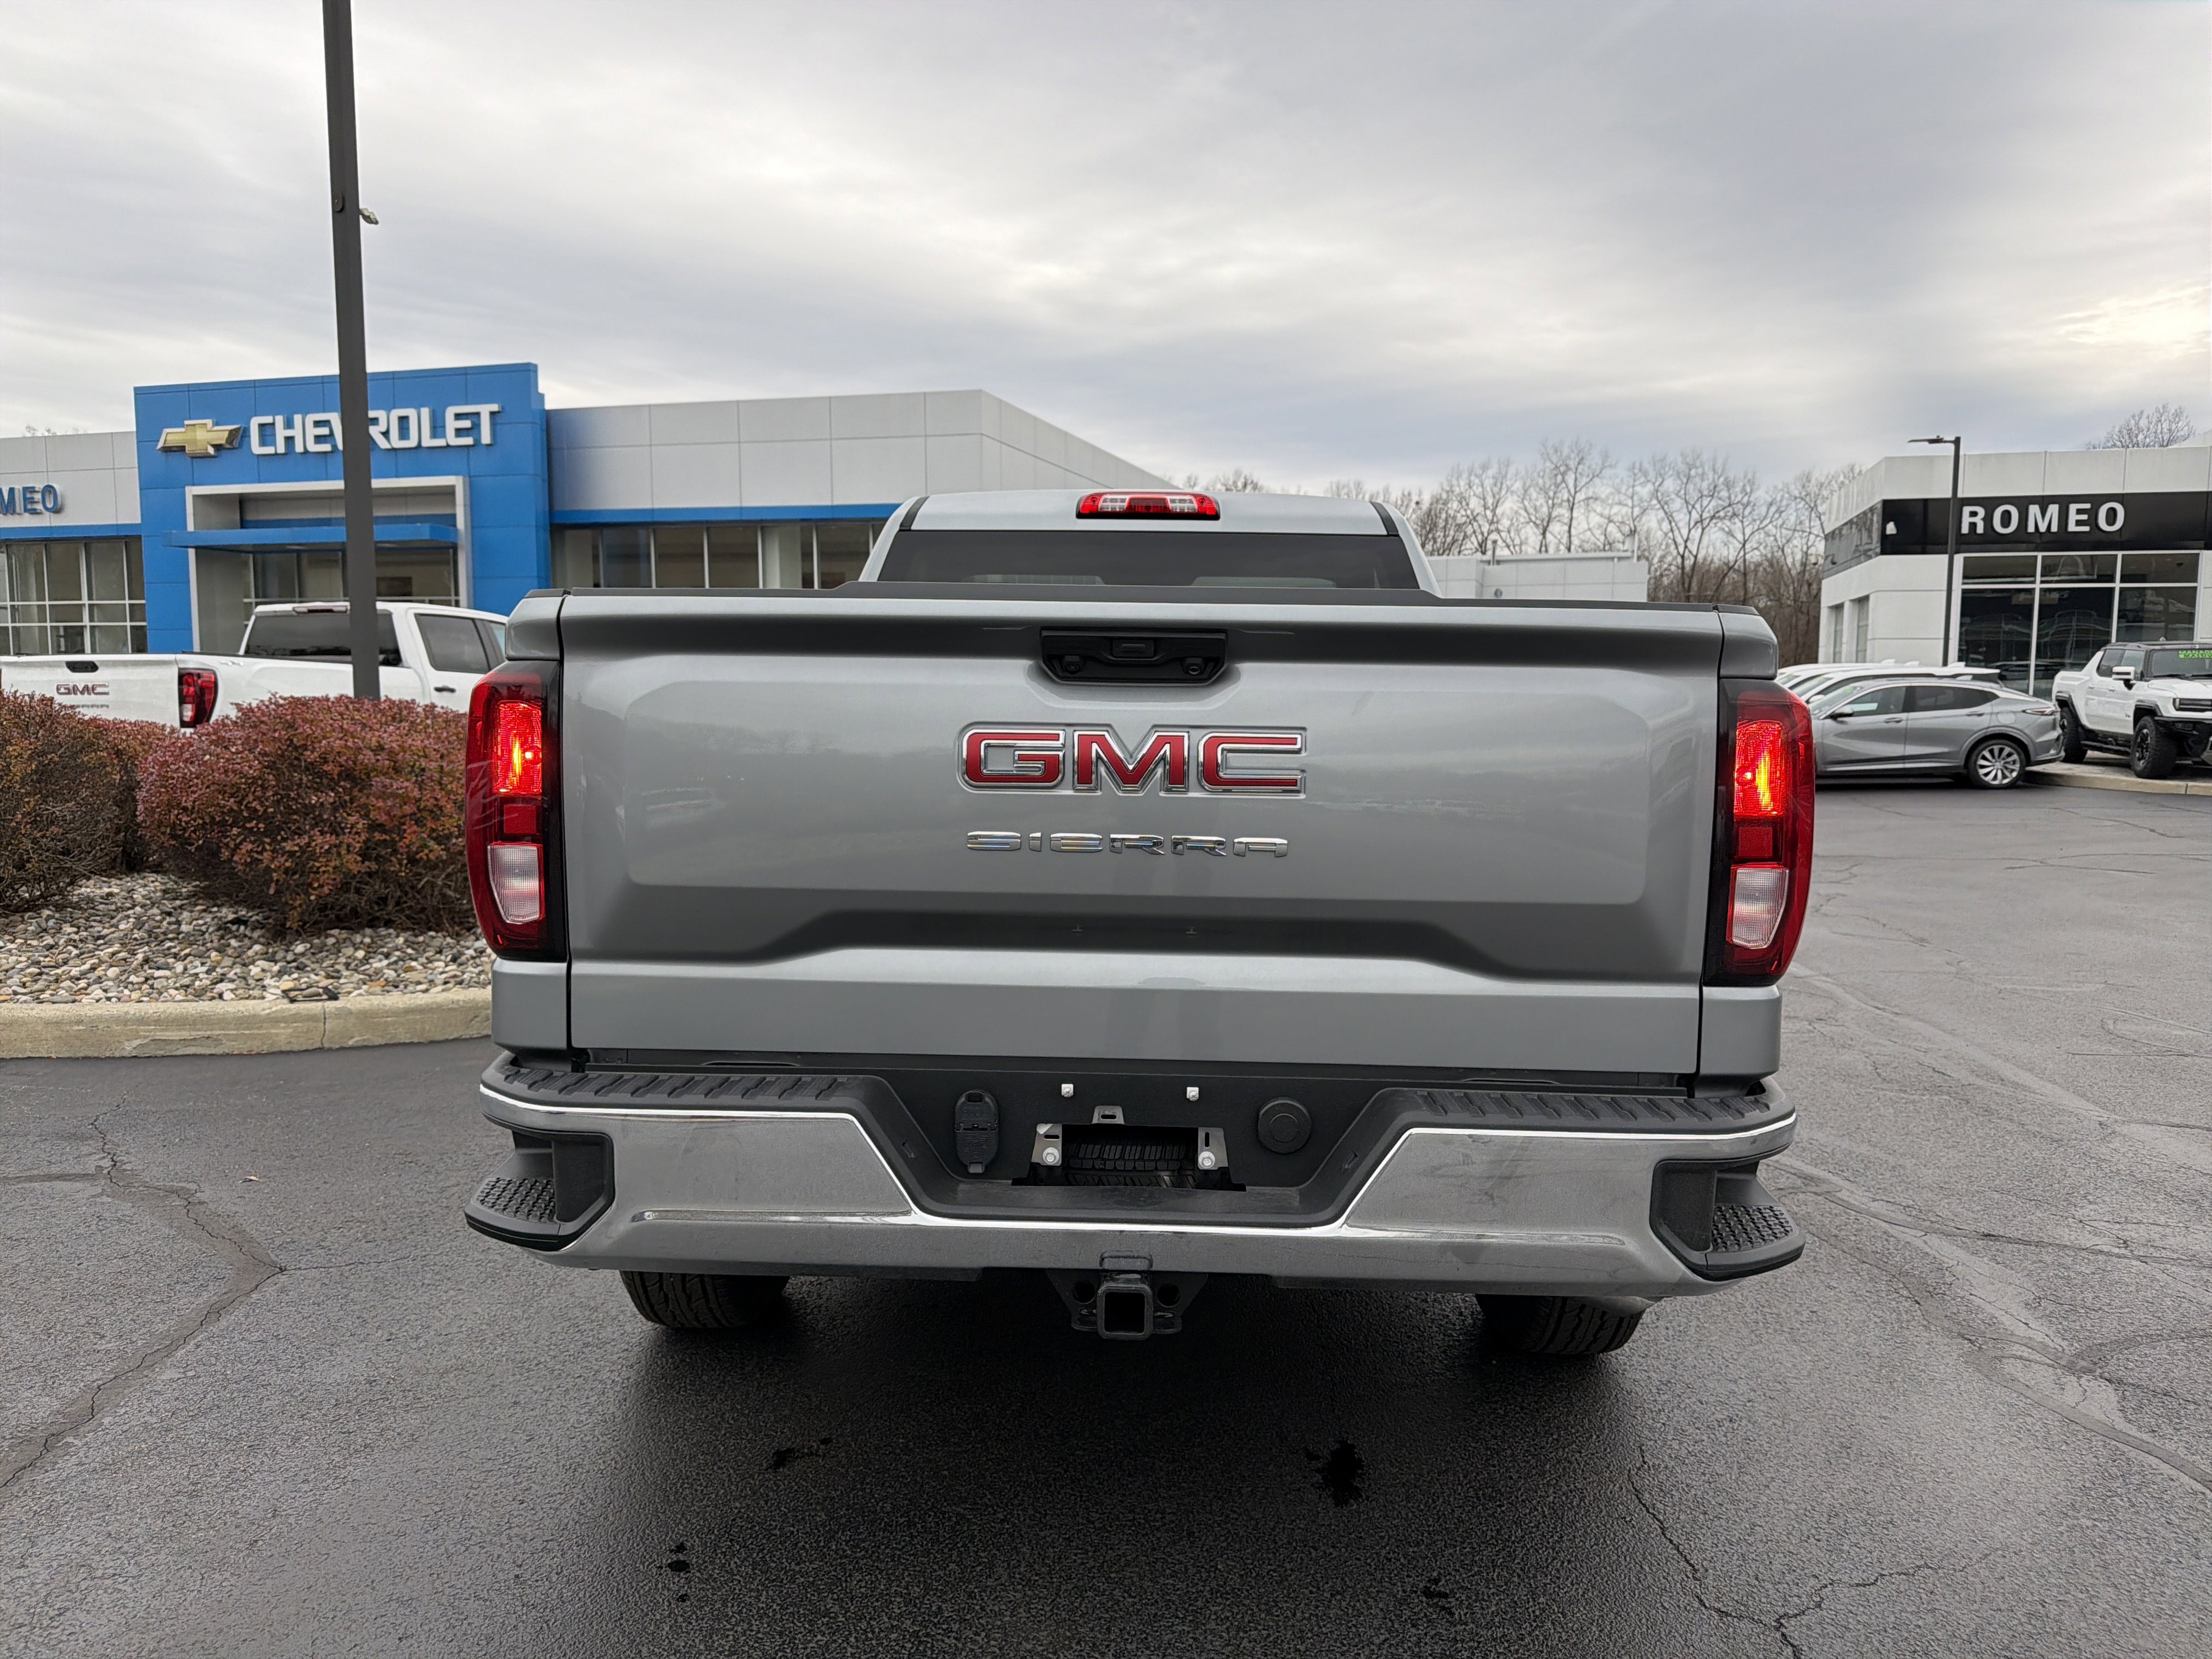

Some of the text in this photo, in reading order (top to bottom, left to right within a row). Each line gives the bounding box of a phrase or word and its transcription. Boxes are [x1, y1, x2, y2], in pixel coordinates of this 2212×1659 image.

[1961, 501, 2125, 534] ROMEO
[56, 683, 110, 696] GMC
[961, 728, 1304, 795] GMC
[966, 831, 1289, 858] SIERRA
